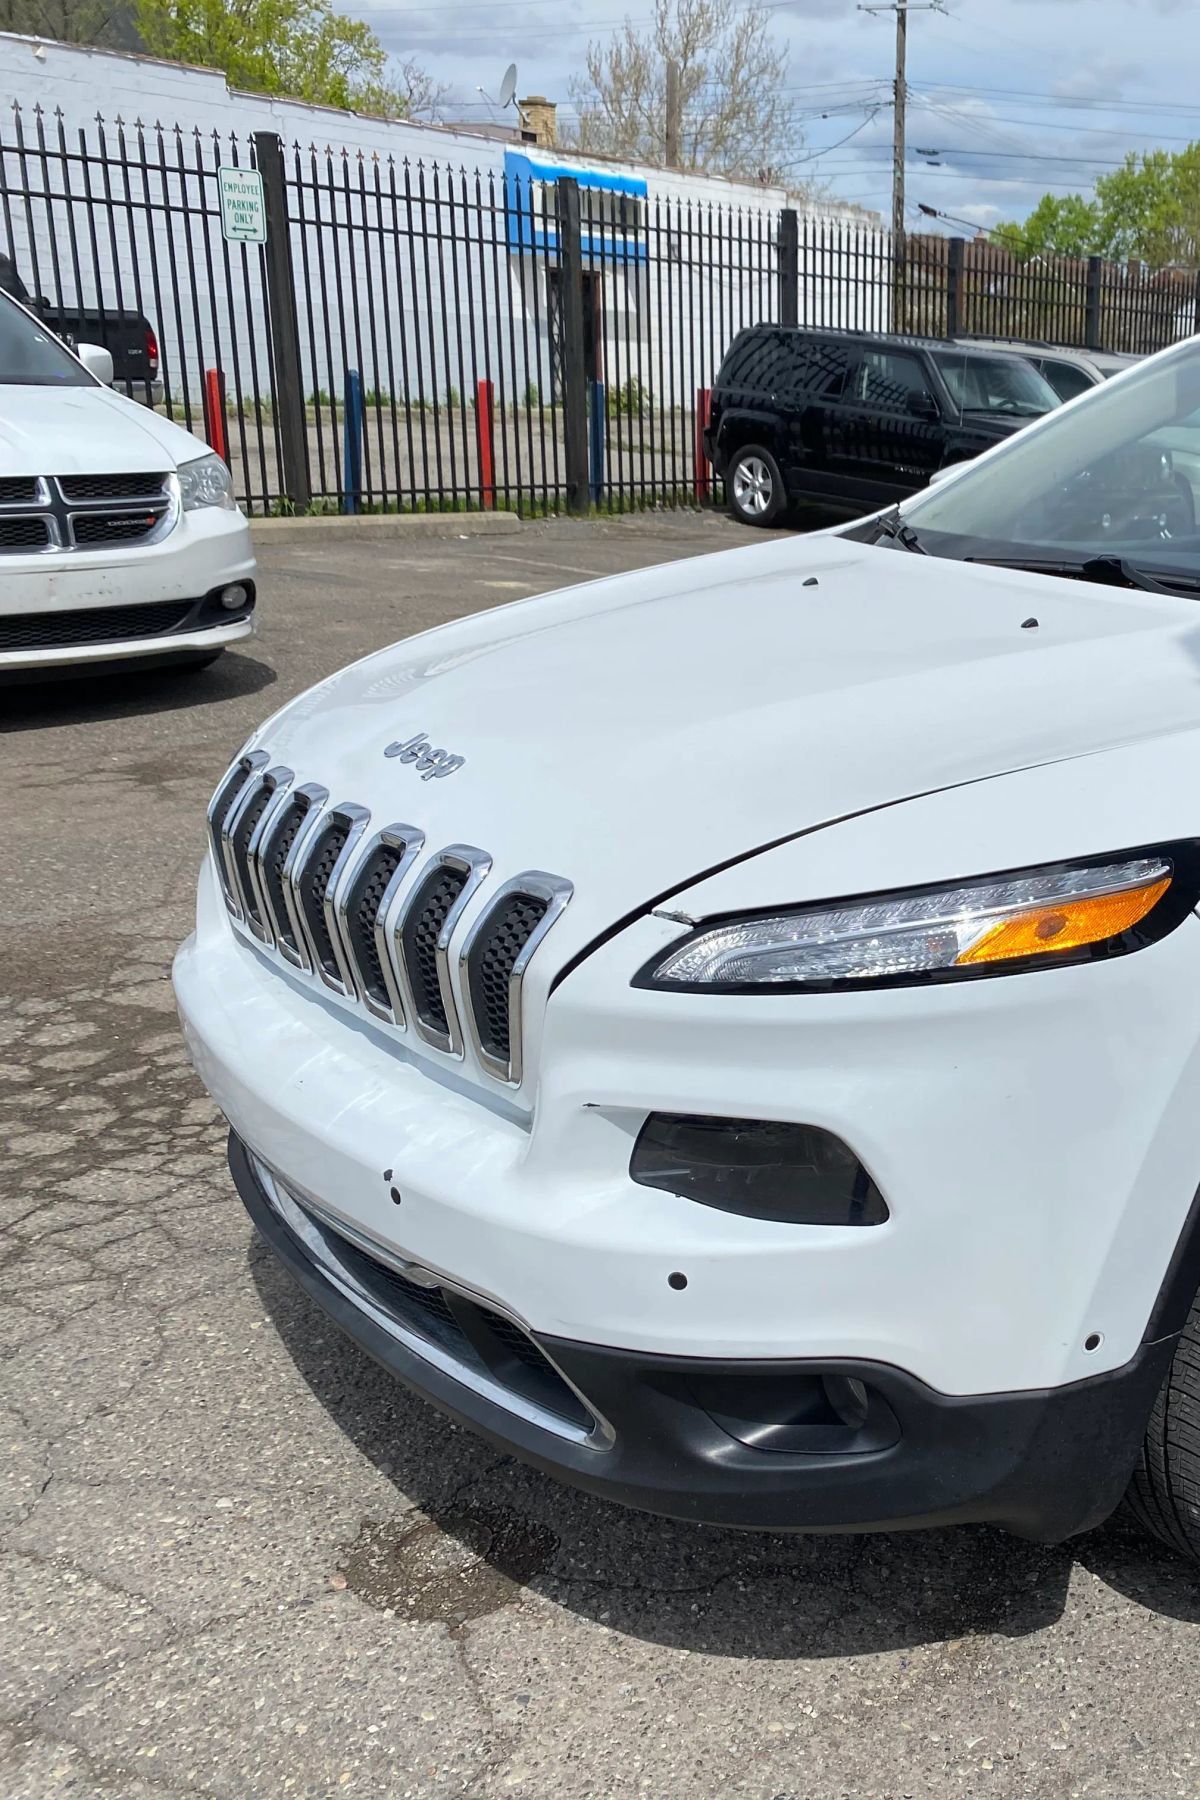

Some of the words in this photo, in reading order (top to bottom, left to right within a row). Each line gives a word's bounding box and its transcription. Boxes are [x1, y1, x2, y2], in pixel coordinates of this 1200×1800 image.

[223, 182, 259, 195] EMPLOYEE
[227, 199, 259, 213] PARKING
[234, 212, 254, 224] ONLY
[383, 732, 466, 782] Jeep
